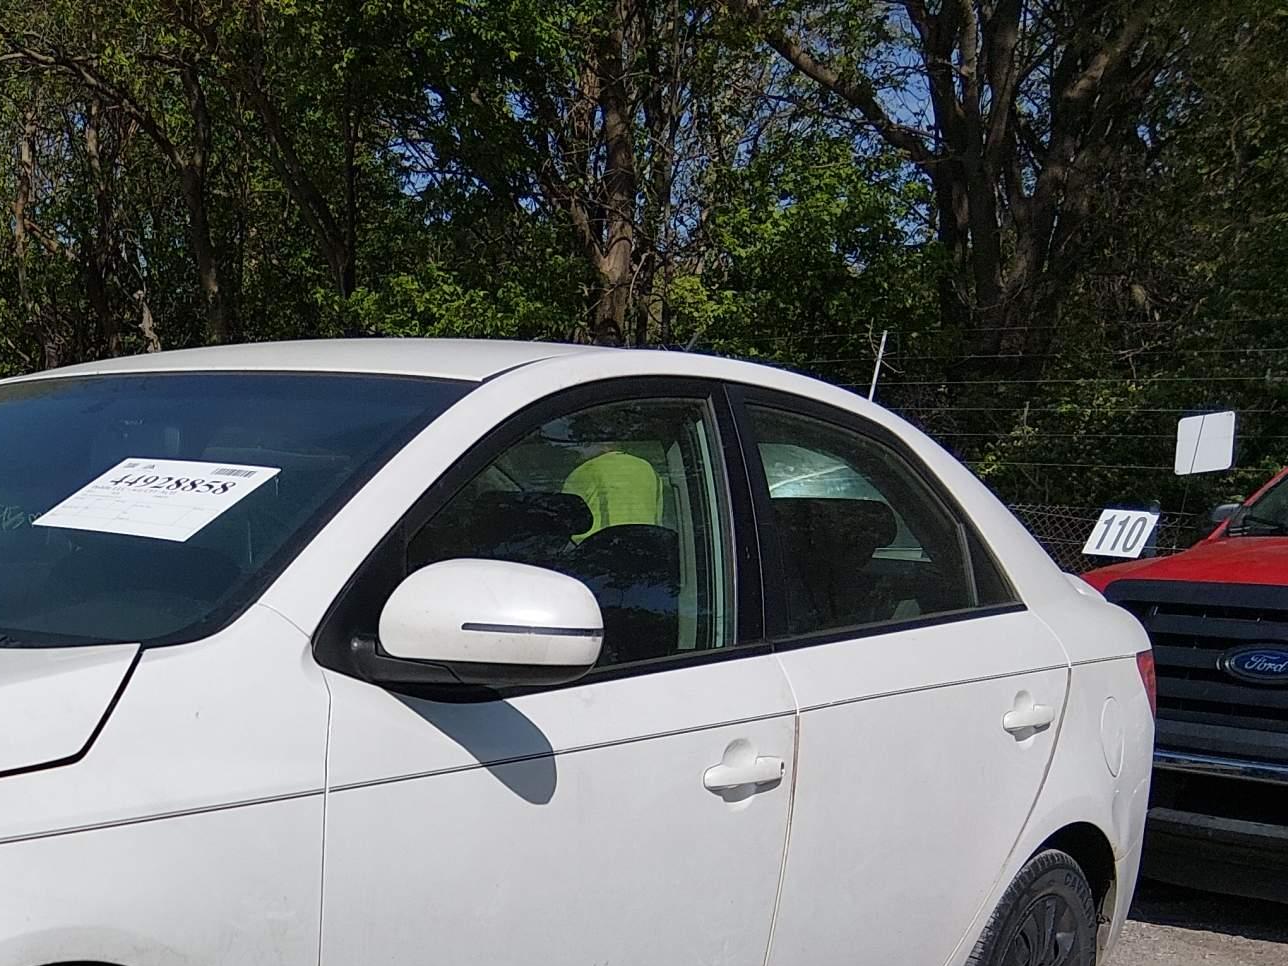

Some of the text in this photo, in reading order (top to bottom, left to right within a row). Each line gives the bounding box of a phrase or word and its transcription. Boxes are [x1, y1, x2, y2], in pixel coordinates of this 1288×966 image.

[110, 473, 237, 495] 44928858
[1095, 514, 1148, 553] 110
[1244, 654, 1288, 673] Ford
